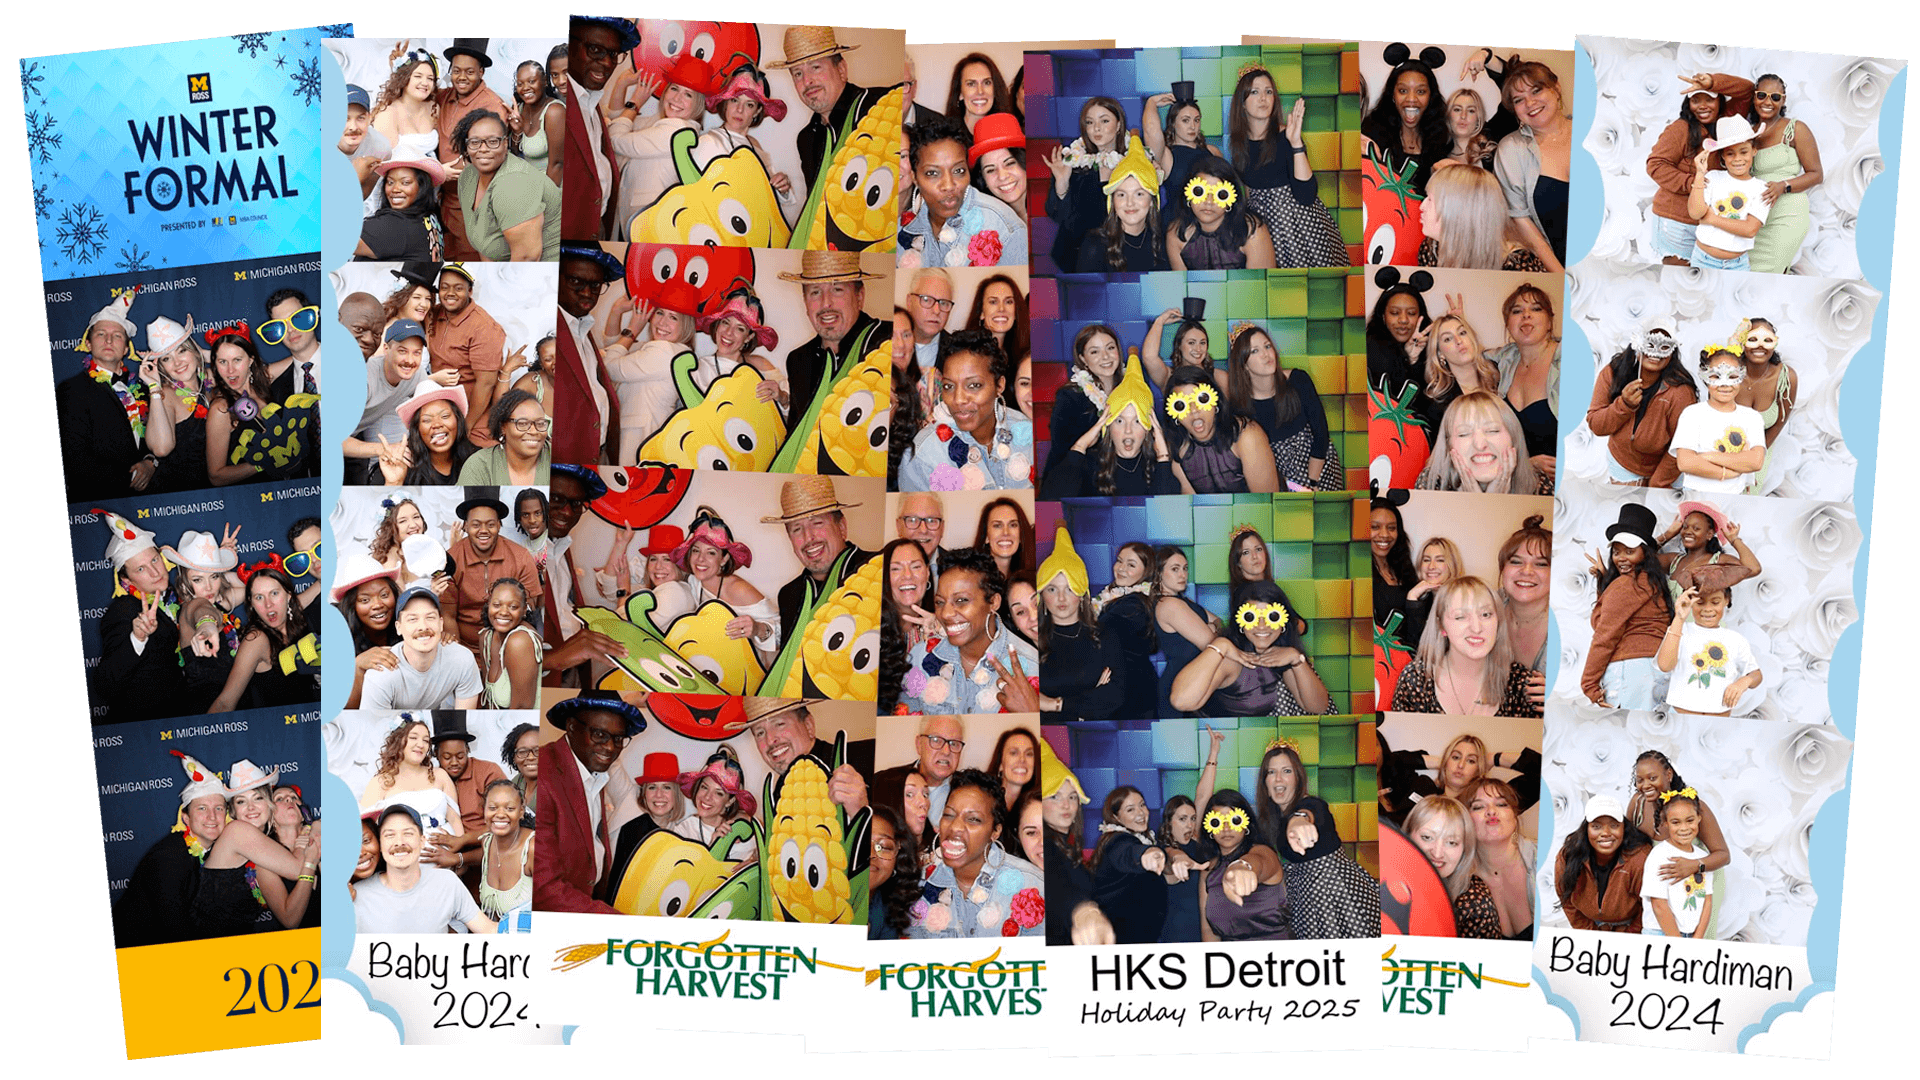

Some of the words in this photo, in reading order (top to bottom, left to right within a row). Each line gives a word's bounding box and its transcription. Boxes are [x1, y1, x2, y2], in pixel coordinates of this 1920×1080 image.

[234, 271, 247, 281] M
[250, 265, 298, 279] MICHIGAN
[298, 260, 321, 273] ROSS
[173, 277, 198, 290] ROSS
[47, 292, 73, 303] ROSS
[193, 320, 223, 335] HIGAN
[260, 491, 274, 503] M
[137, 508, 150, 519] M
[153, 502, 200, 517] MICHIGAN
[201, 500, 225, 512] ROSS
[74, 513, 99, 525] ROSS
[250, 539, 275, 552] ROSS
[284, 714, 298, 725] M
[160, 730, 172, 741] M
[176, 723, 223, 739] MICHIGAN
[224, 721, 249, 733] ROSS
[99, 735, 123, 748] ROSS
[101, 780, 149, 795] MICHIGAN
[149, 777, 173, 790] ROSS
[109, 829, 135, 842] ROSS
